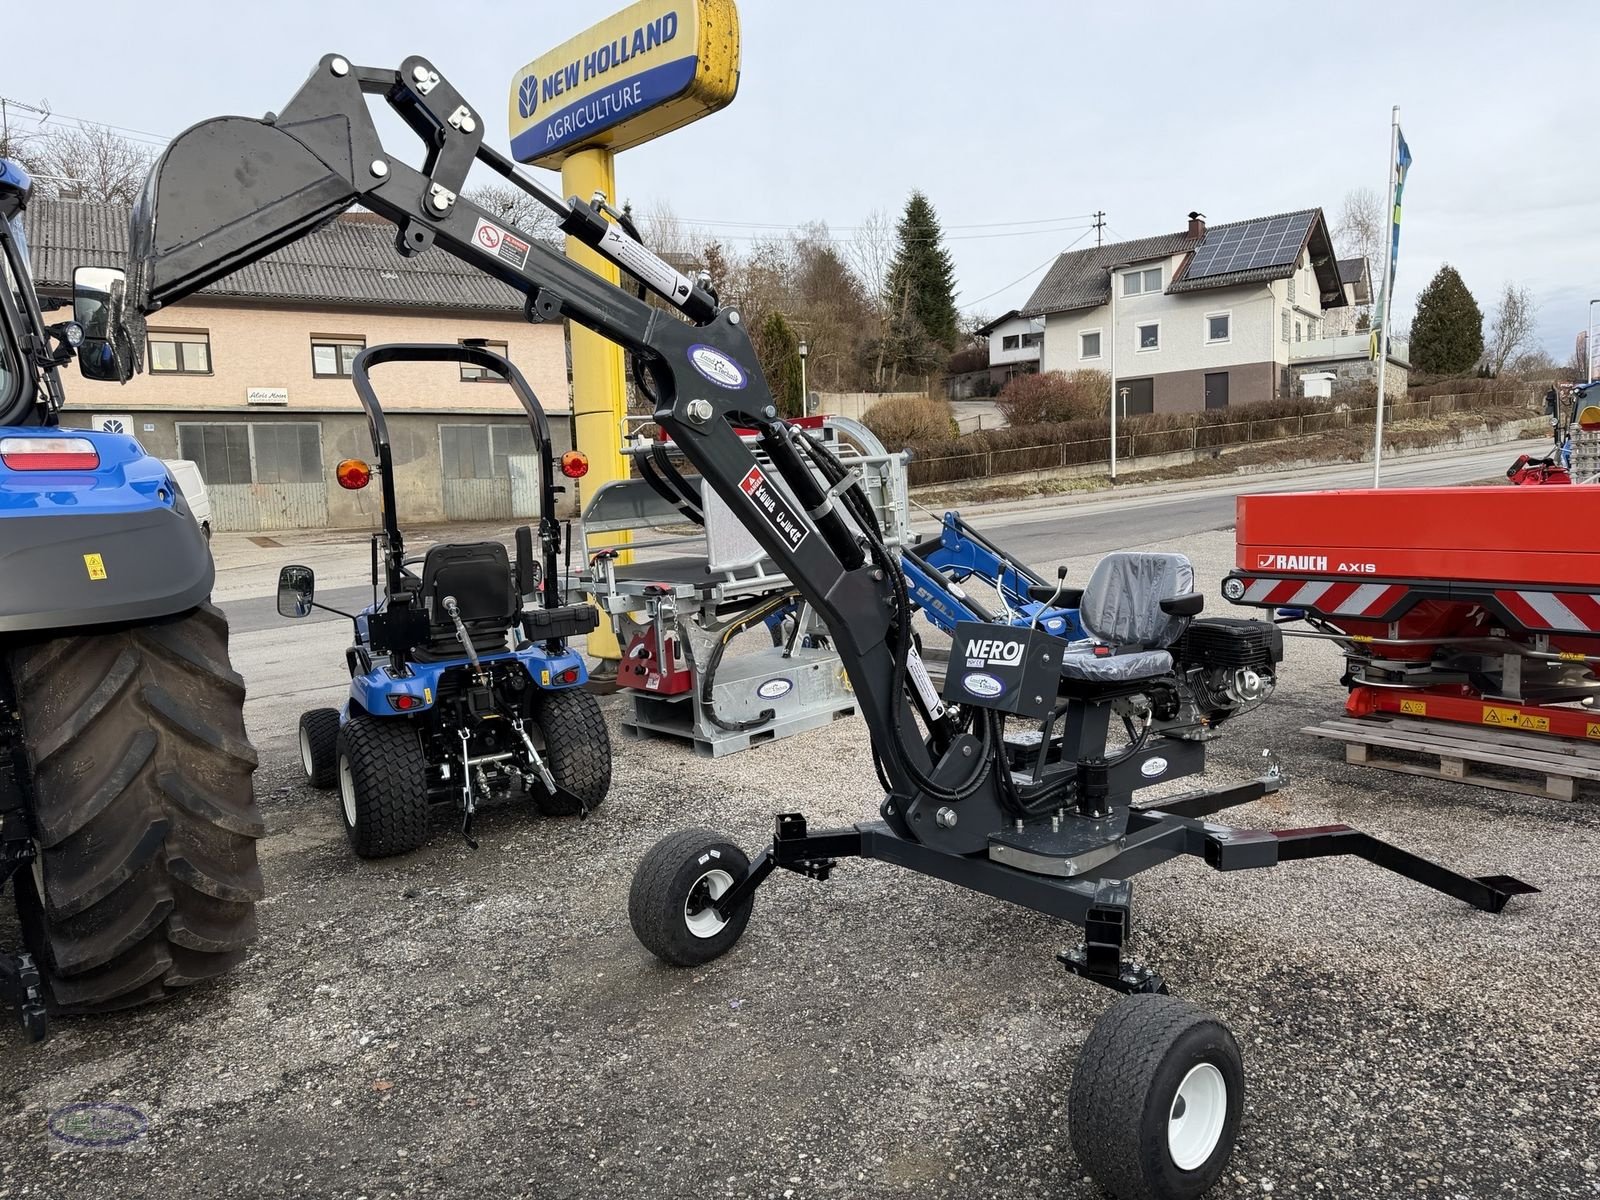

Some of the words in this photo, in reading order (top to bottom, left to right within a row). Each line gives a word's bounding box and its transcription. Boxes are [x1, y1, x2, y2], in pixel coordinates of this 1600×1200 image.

[542, 59, 581, 104] NEW
[583, 11, 678, 82] HOLLAND
[545, 81, 642, 144] AGRICULTURE
[700, 352, 715, 365] Land
[747, 476, 764, 496] DANGER
[755, 484, 776, 513] KEEP
[776, 511, 802, 543] CLEAR
[1276, 555, 1328, 571] RAUCH
[1337, 563, 1377, 573] AXIS
[965, 639, 1019, 660] NERO
